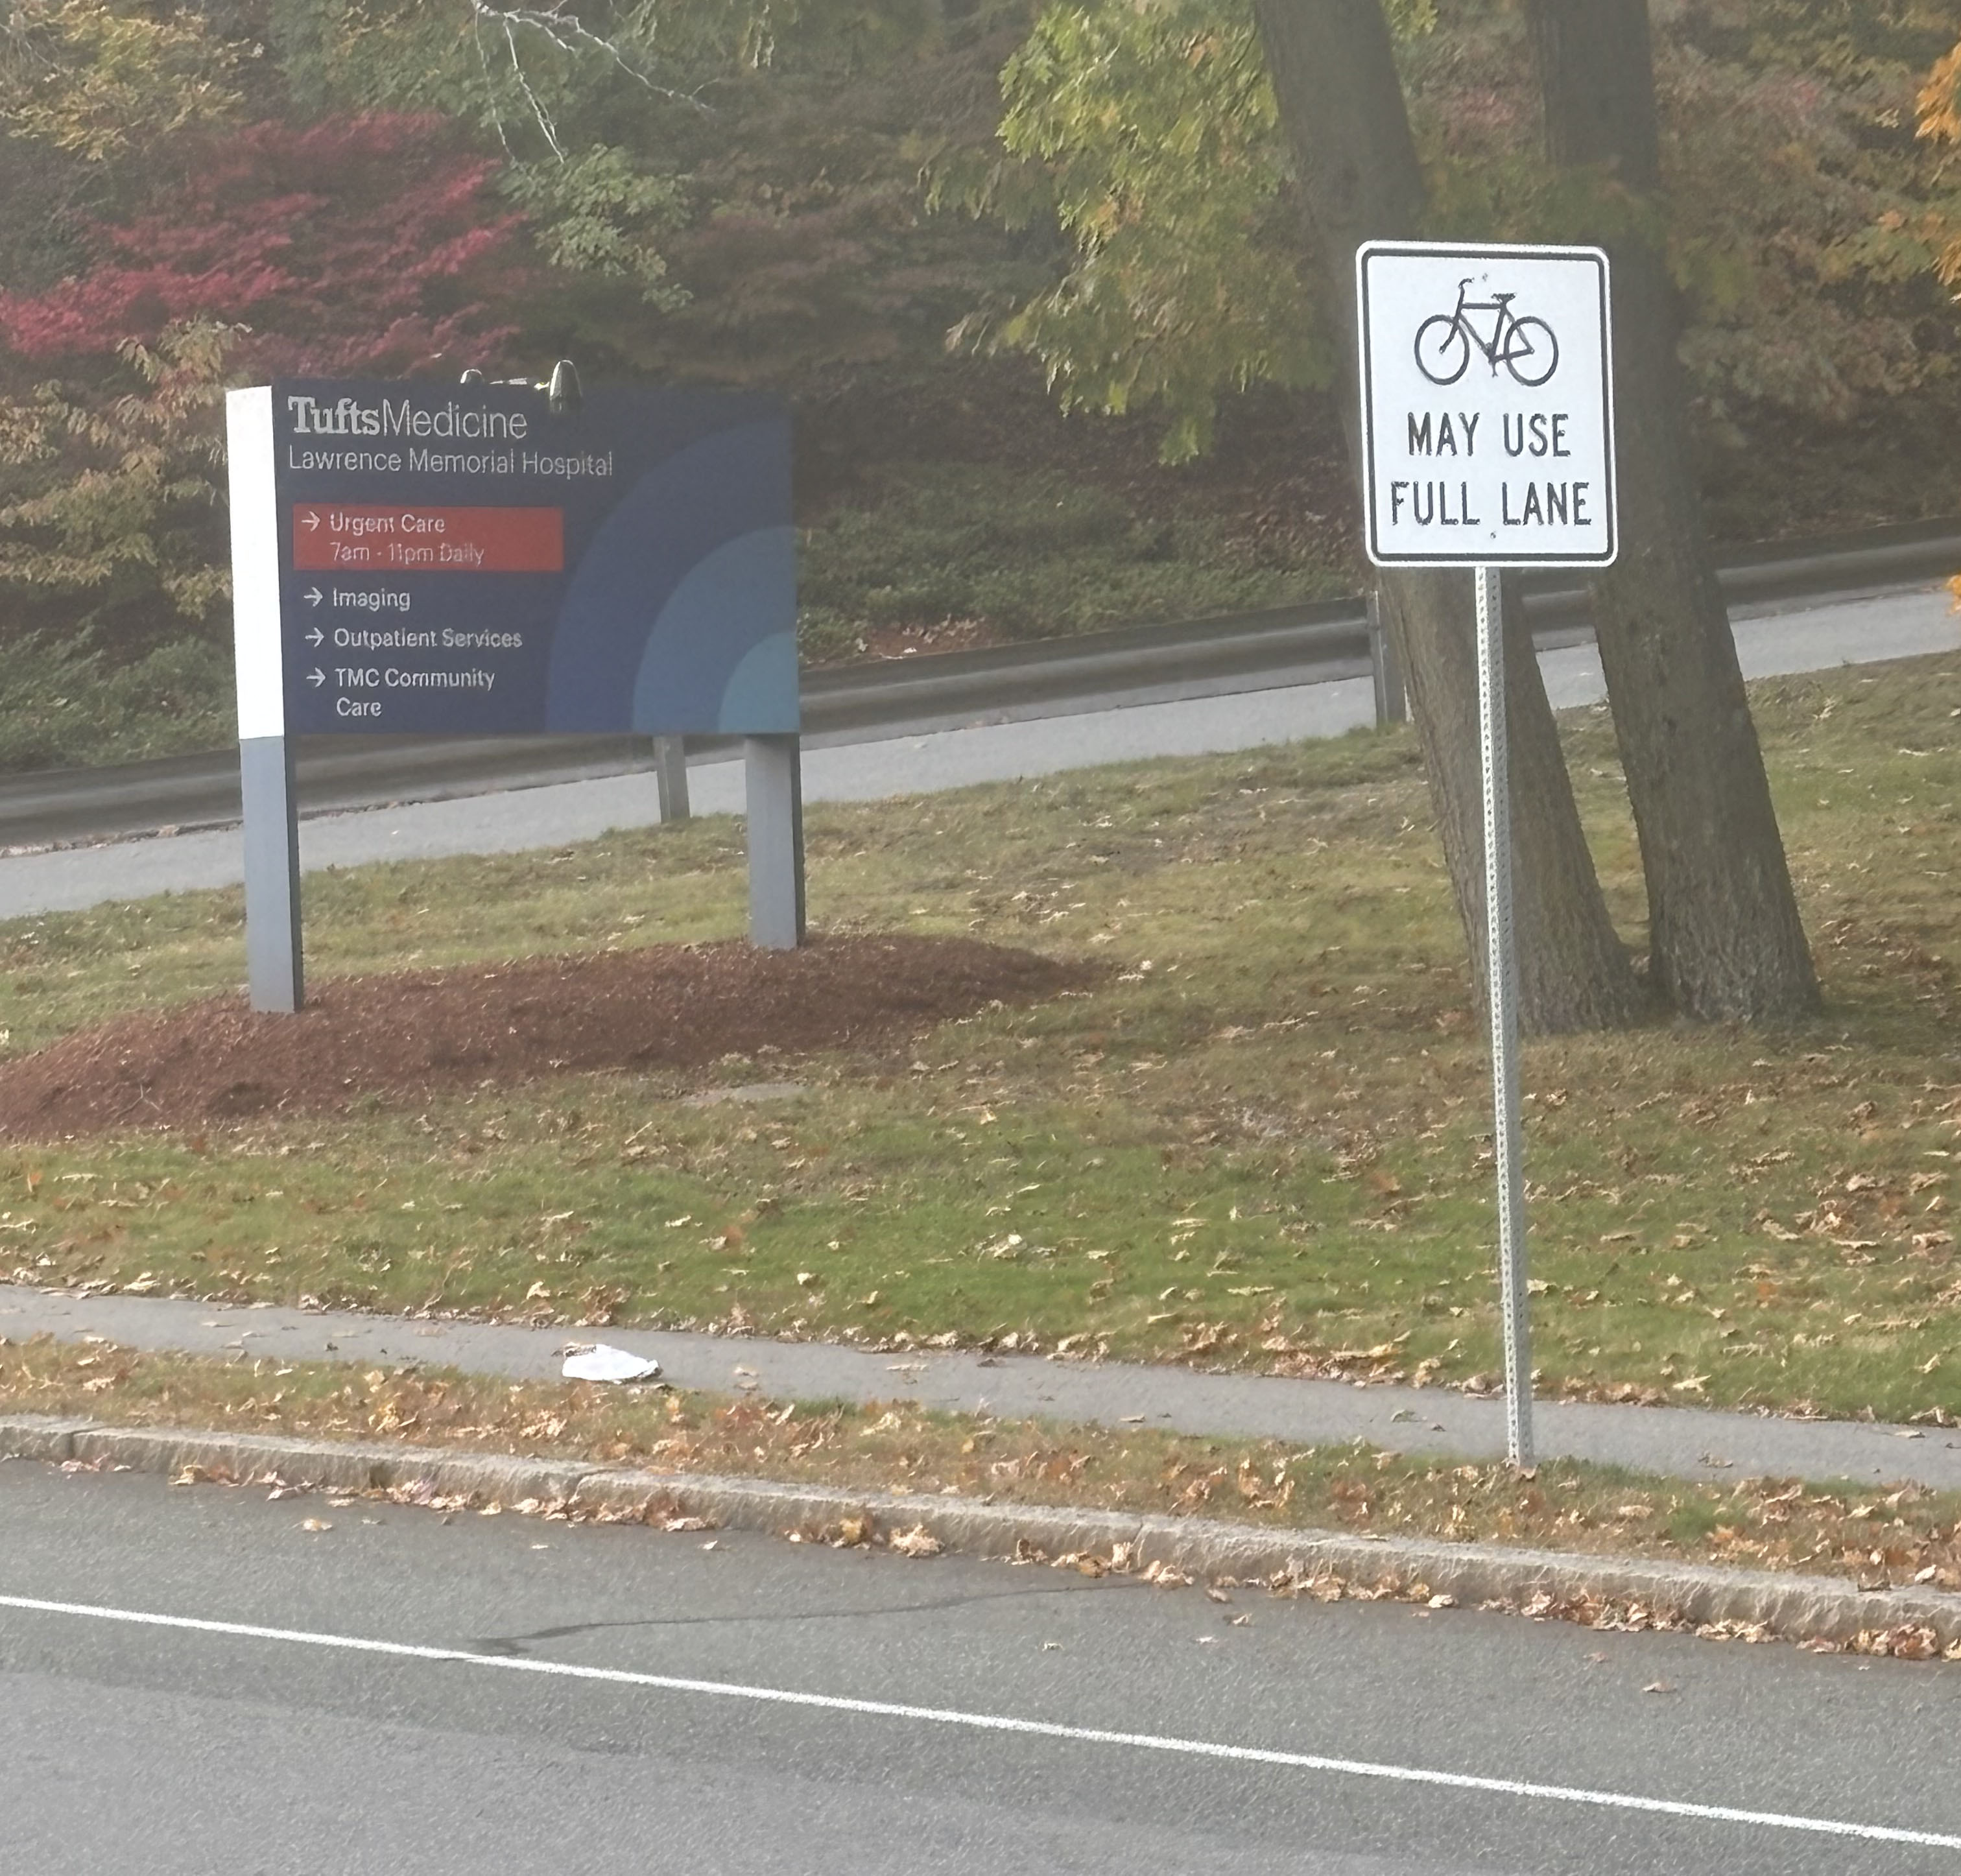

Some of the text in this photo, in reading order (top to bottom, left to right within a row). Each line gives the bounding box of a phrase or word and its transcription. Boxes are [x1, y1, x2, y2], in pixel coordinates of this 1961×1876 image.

[288, 396, 527, 439] TuftsMedicine
[1407, 411, 1571, 457] MAY USE
[289, 445, 613, 480] Lawrence Memorial Hospital
[1390, 481, 1592, 526] FULL LANE
[329, 512, 446, 536] Urgent Care
[329, 542, 370, 562] 7am
[388, 543, 433, 565] 11pm
[440, 543, 485, 567] Daily
[333, 588, 411, 611] Imaging
[333, 627, 523, 650] Outpatient Services
[334, 668, 495, 691] TMC Community
[336, 696, 382, 717] Care
